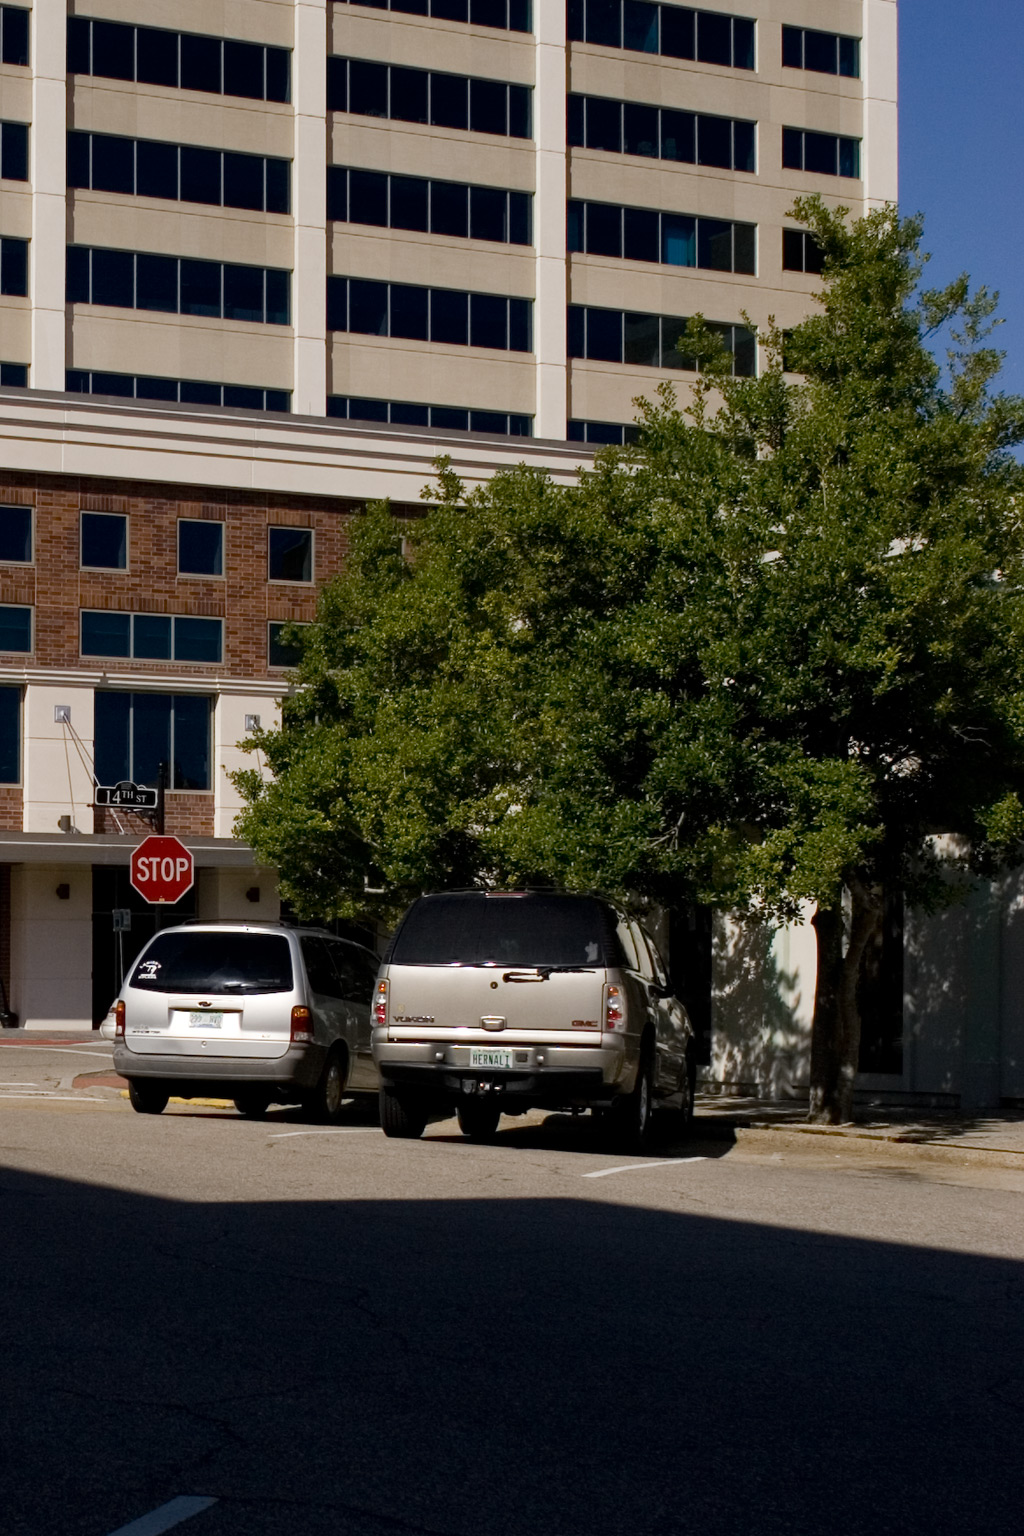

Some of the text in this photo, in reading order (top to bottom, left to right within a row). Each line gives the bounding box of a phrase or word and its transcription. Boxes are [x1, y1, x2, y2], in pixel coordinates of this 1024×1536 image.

[105, 790, 147, 805] 14TH ST
[136, 856, 189, 882] STOP
[393, 1015, 435, 1023] YUKON
